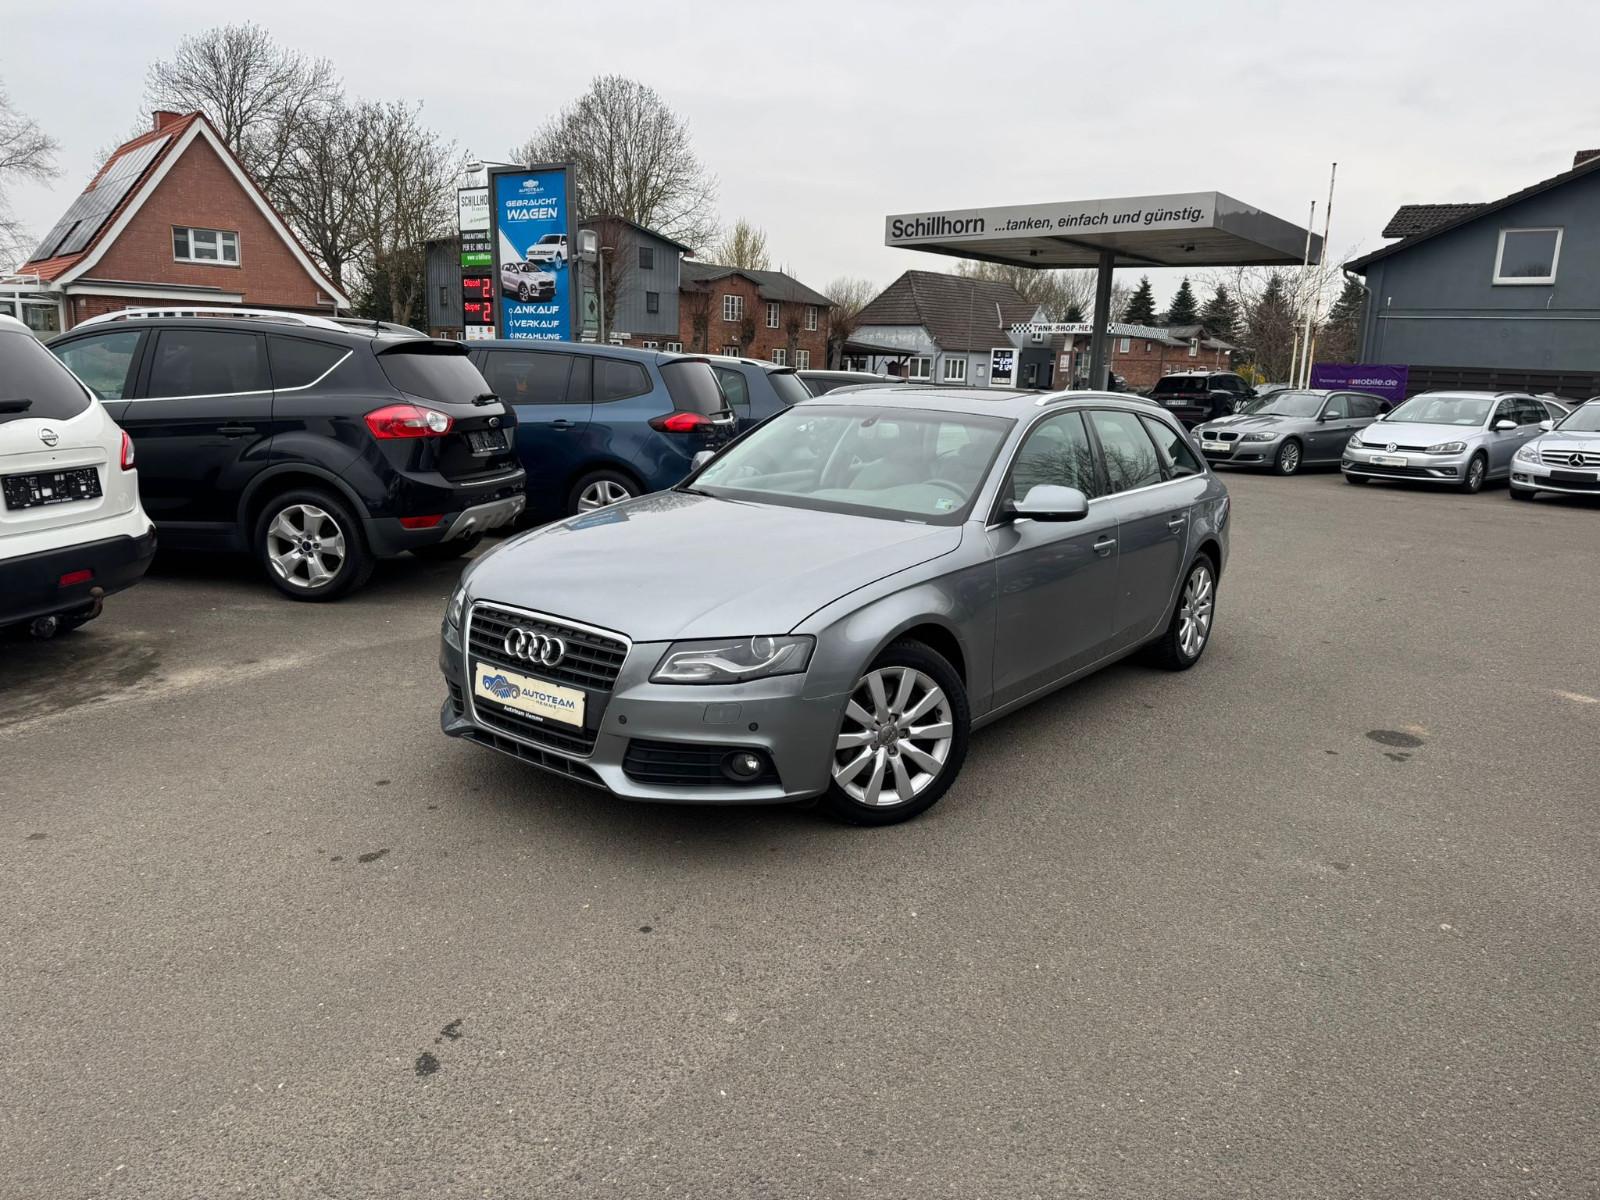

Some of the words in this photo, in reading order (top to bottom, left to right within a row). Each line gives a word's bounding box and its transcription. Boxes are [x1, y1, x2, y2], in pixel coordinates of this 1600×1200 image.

[505, 198, 557, 207] GEBRAUCHT
[507, 207, 558, 221] WAGEN
[892, 216, 984, 238] Schillhorn
[994, 217, 1054, 232] ...tanken,
[1057, 212, 1109, 228] einfach
[1112, 210, 1142, 225] und
[1144, 206, 1205, 226] günstig.
[514, 305, 560, 314] ANKAUF
[514, 320, 560, 328] VERKAUF
[1352, 378, 1398, 386] mobile.de
[522, 688, 575, 709] AUTOTEAM
